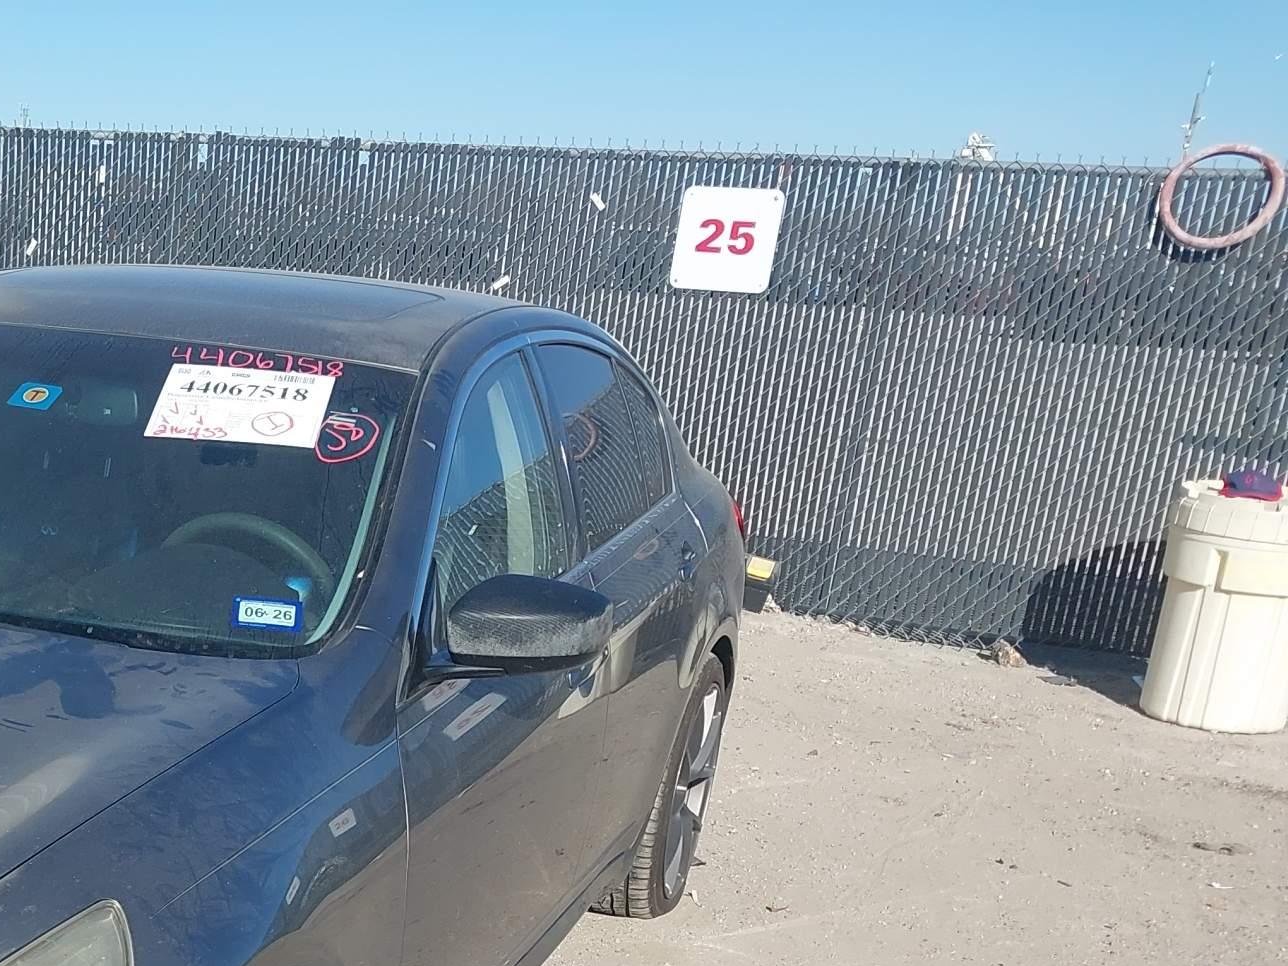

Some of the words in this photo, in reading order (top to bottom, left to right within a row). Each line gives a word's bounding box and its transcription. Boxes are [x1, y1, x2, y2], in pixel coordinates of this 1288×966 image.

[695, 219, 756, 255] 25
[171, 346, 344, 378] 44067518
[180, 380, 308, 401] 44067518
[244, 606, 264, 618] 06
[272, 609, 293, 621] 26
